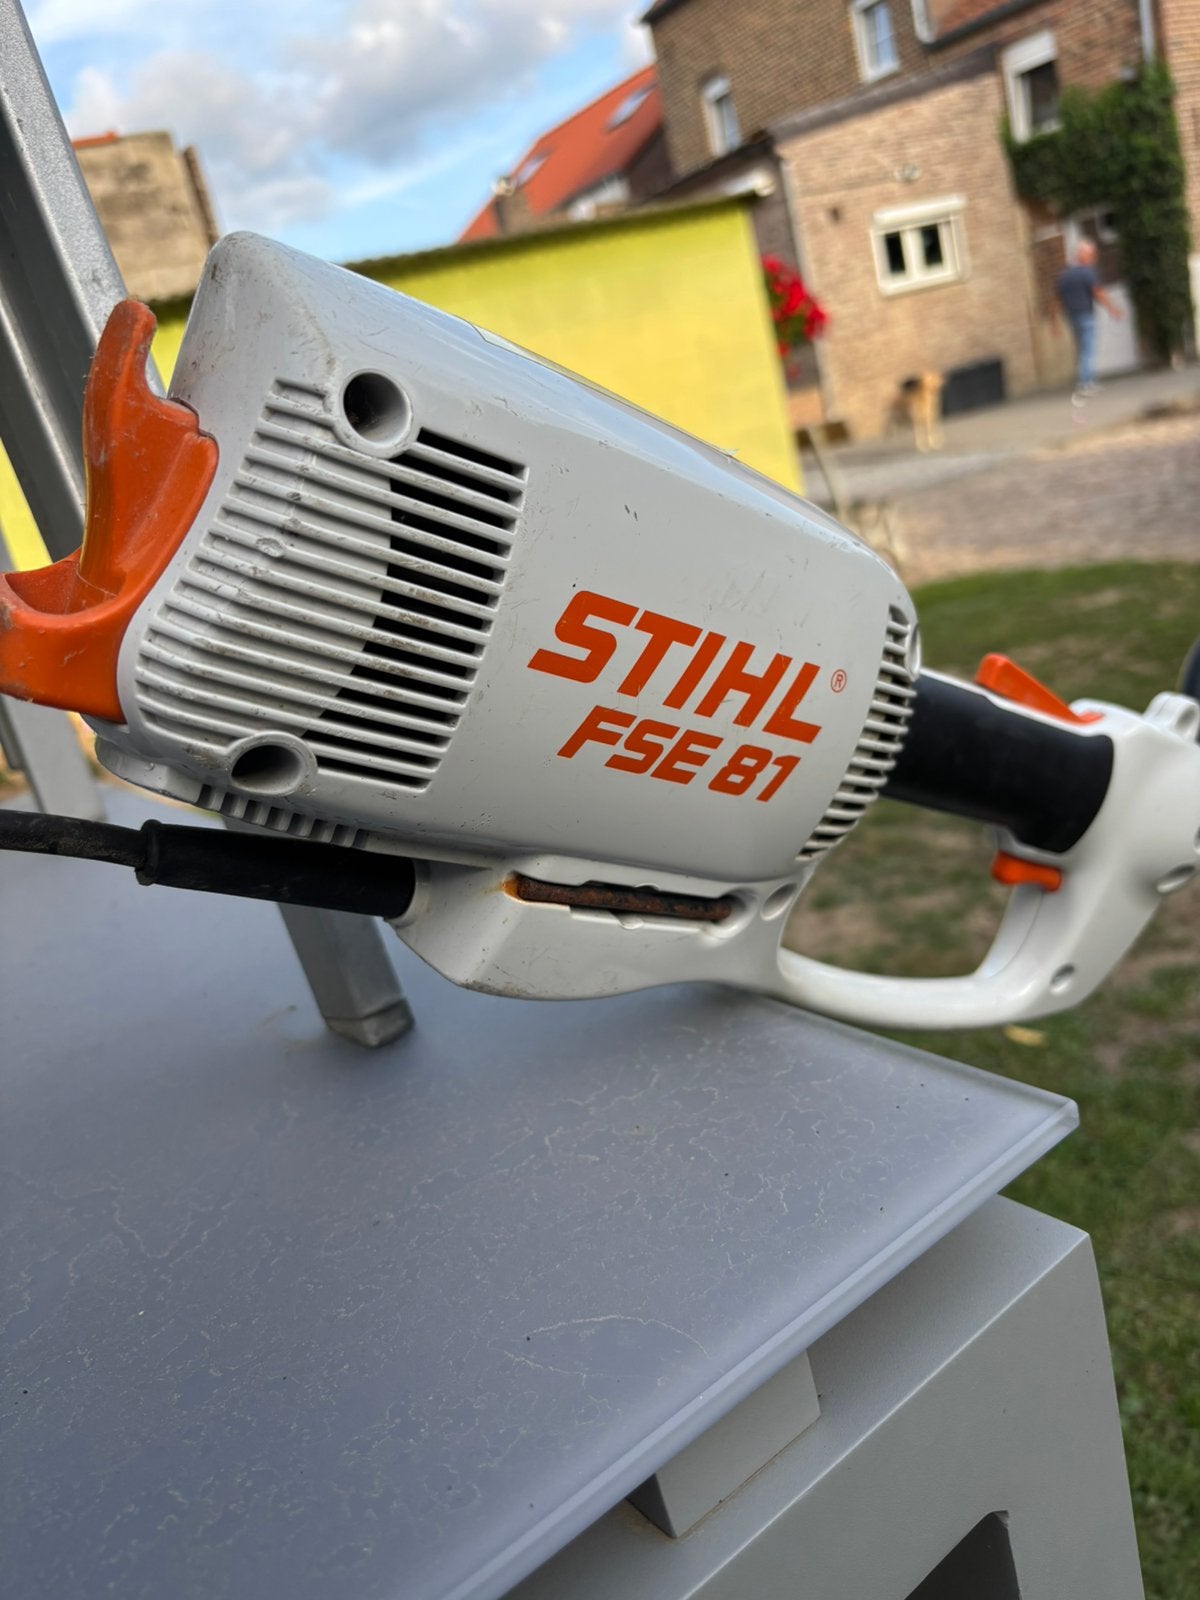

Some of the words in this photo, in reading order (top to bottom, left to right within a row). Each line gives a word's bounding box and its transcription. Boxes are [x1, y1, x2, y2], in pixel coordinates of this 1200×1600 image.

[527, 590, 822, 744] STIHL
[557, 705, 724, 785] FSE
[708, 744, 801, 802] 81
